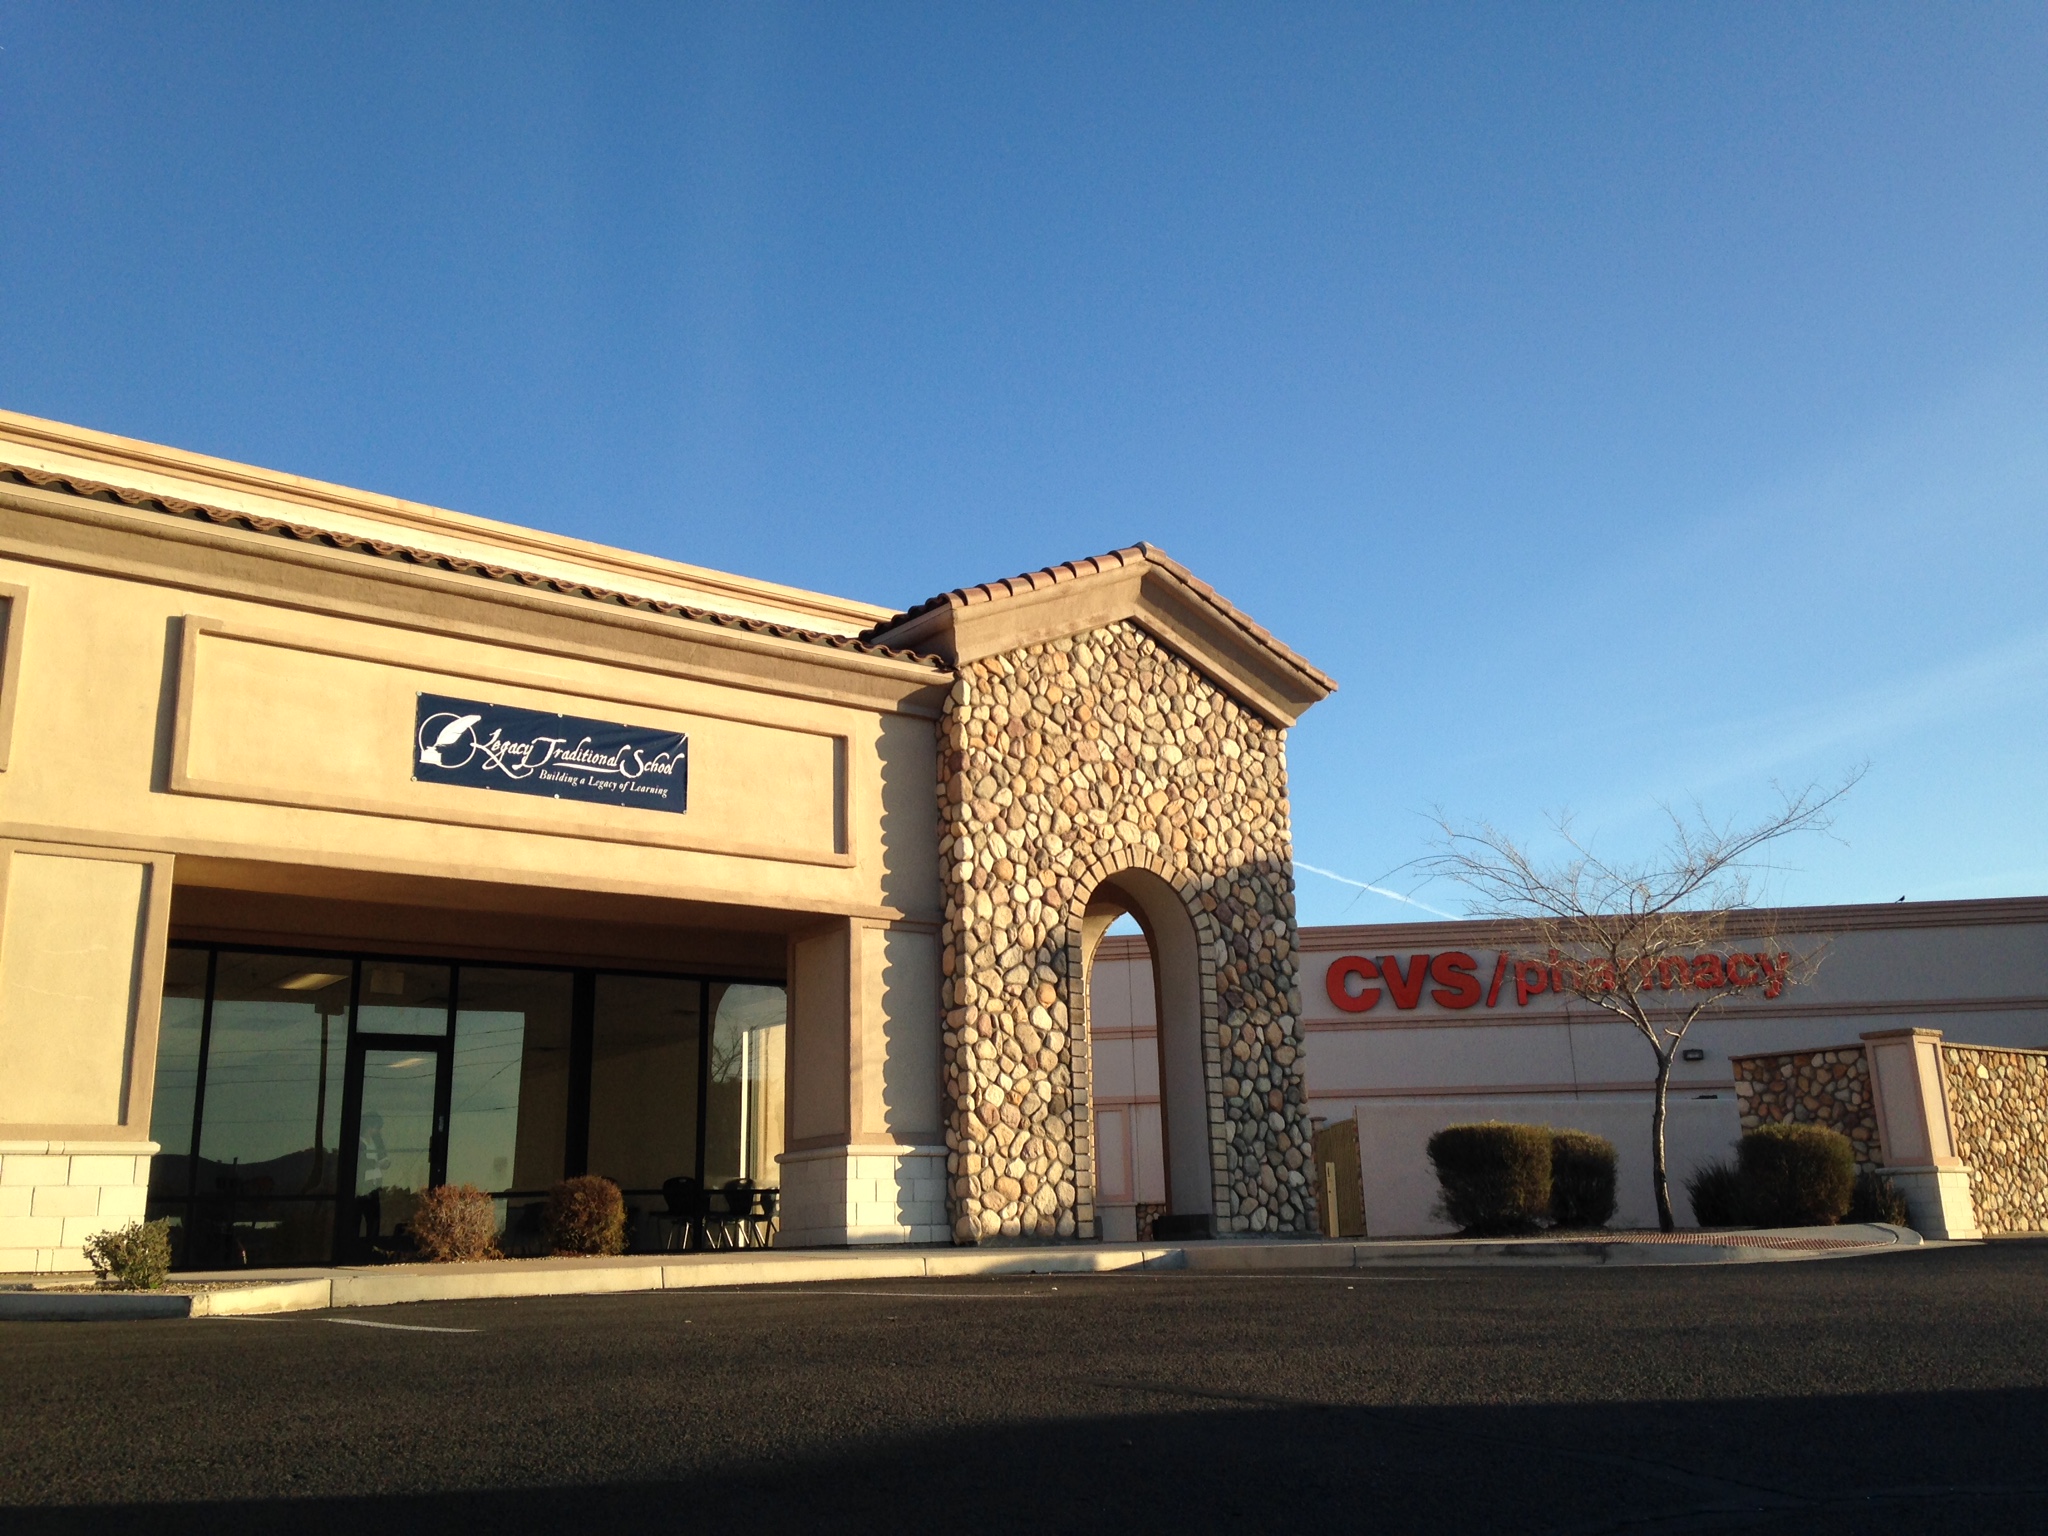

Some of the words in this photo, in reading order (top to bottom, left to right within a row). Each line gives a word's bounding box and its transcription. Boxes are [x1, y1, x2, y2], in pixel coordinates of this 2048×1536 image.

[470, 728, 533, 779] Legacy
[522, 736, 631, 769] Traditional
[619, 749, 685, 778] School
[538, 769, 579, 787] Building
[588, 775, 618, 791] Legacy
[618, 781, 630, 793] of
[629, 781, 669, 798] Learning
